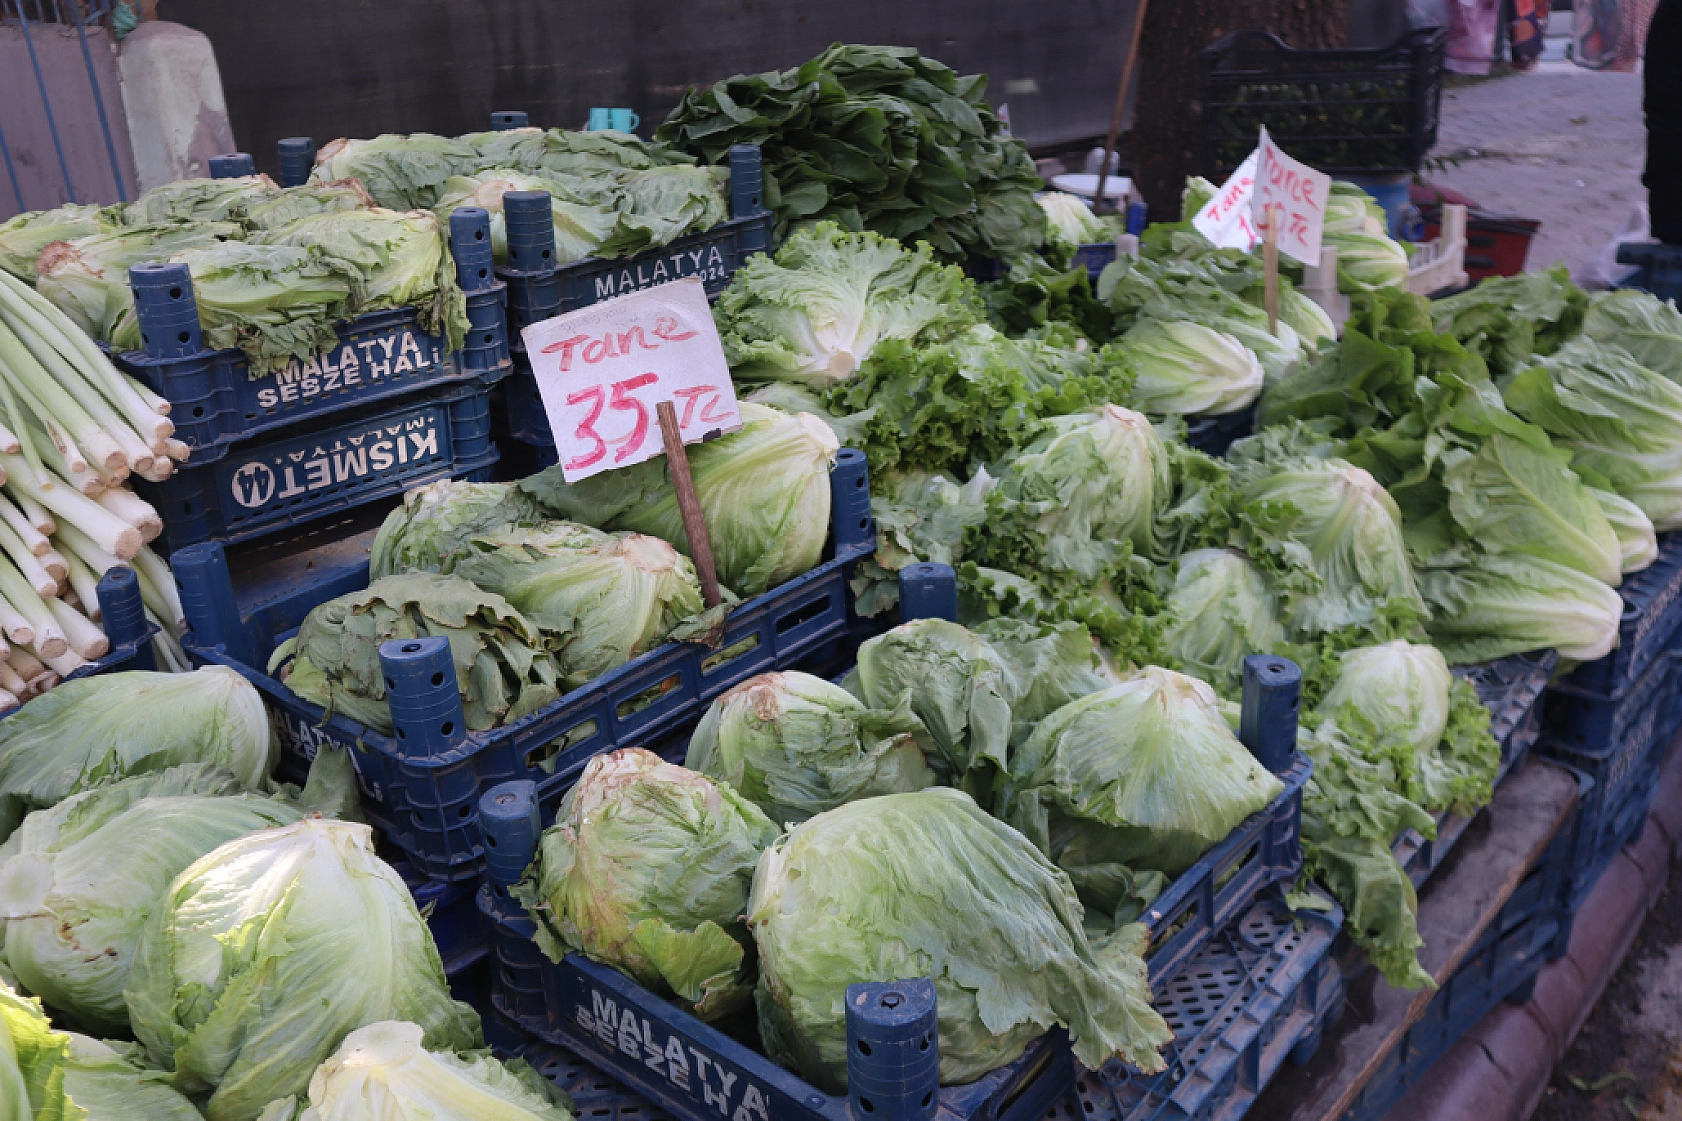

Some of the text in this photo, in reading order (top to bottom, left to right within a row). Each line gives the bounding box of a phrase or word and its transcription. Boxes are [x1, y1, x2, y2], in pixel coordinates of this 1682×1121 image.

[594, 246, 724, 299] MALATYA
[276, 331, 419, 385] MALATYA
[541, 317, 700, 372] Tane
[288, 416, 426, 463] MALATYA
[565, 372, 660, 470] 35
[277, 428, 438, 499] KISMET
[592, 989, 770, 1121] MALATYA
